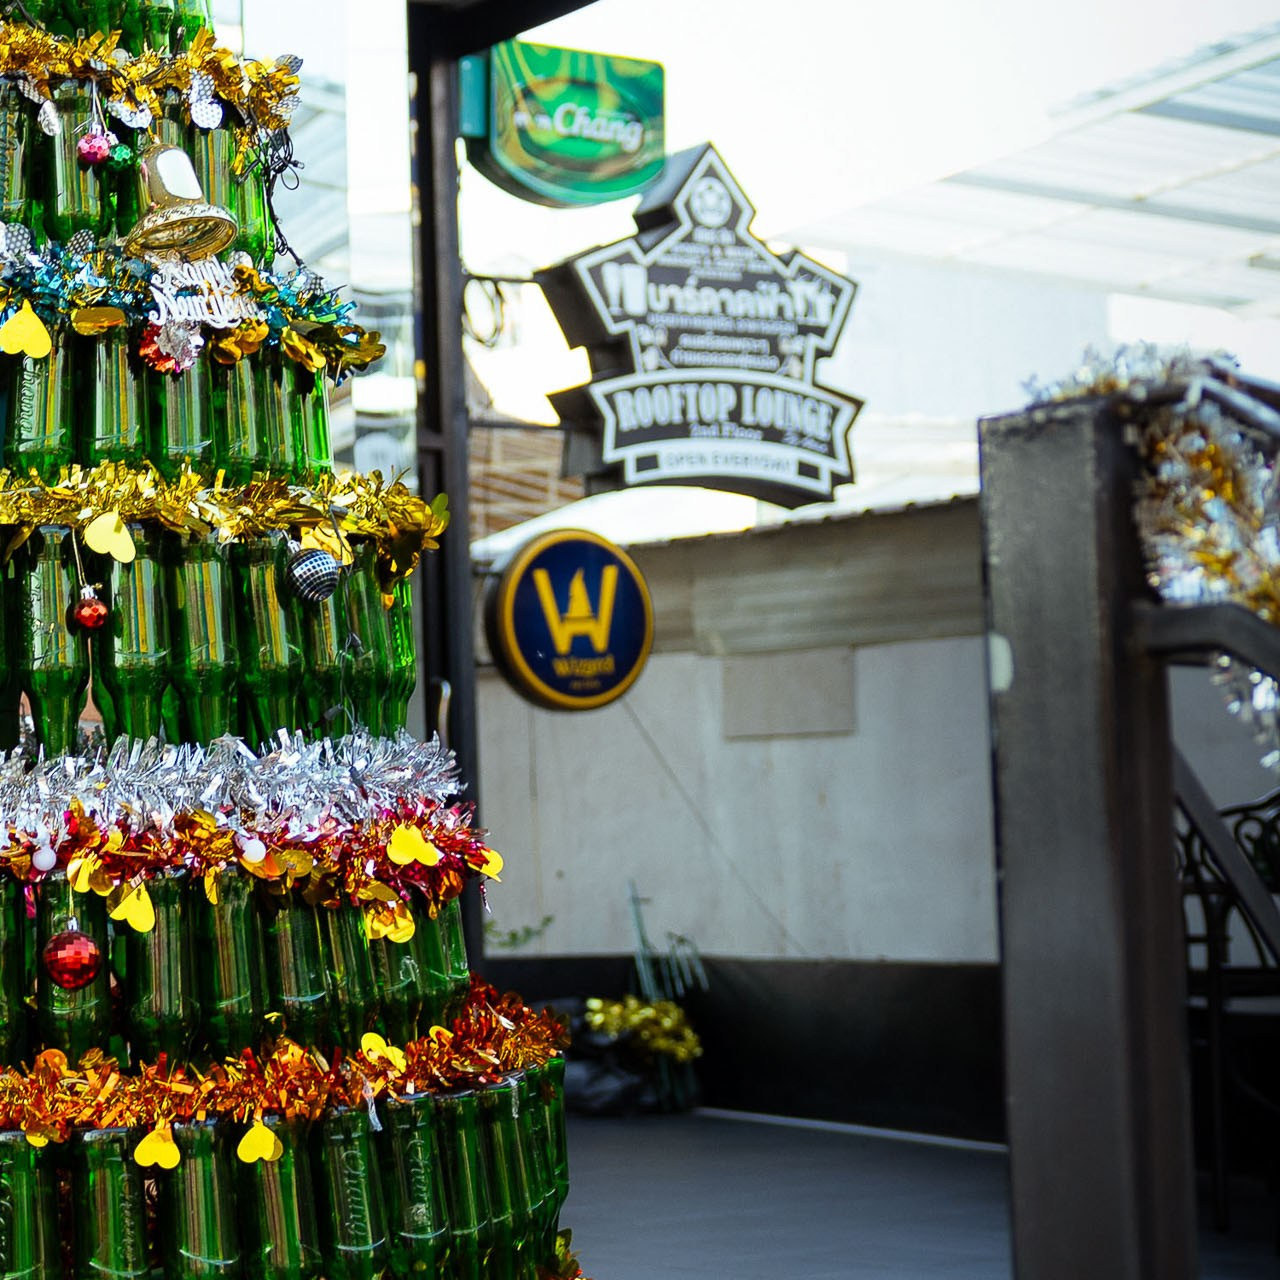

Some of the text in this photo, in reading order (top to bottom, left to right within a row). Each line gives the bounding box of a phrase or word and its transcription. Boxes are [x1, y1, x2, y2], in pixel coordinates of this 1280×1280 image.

[553, 101, 644, 153] Chang
[614, 382, 737, 432] ROOFTOP
[741, 385, 833, 442] LOUNGE
